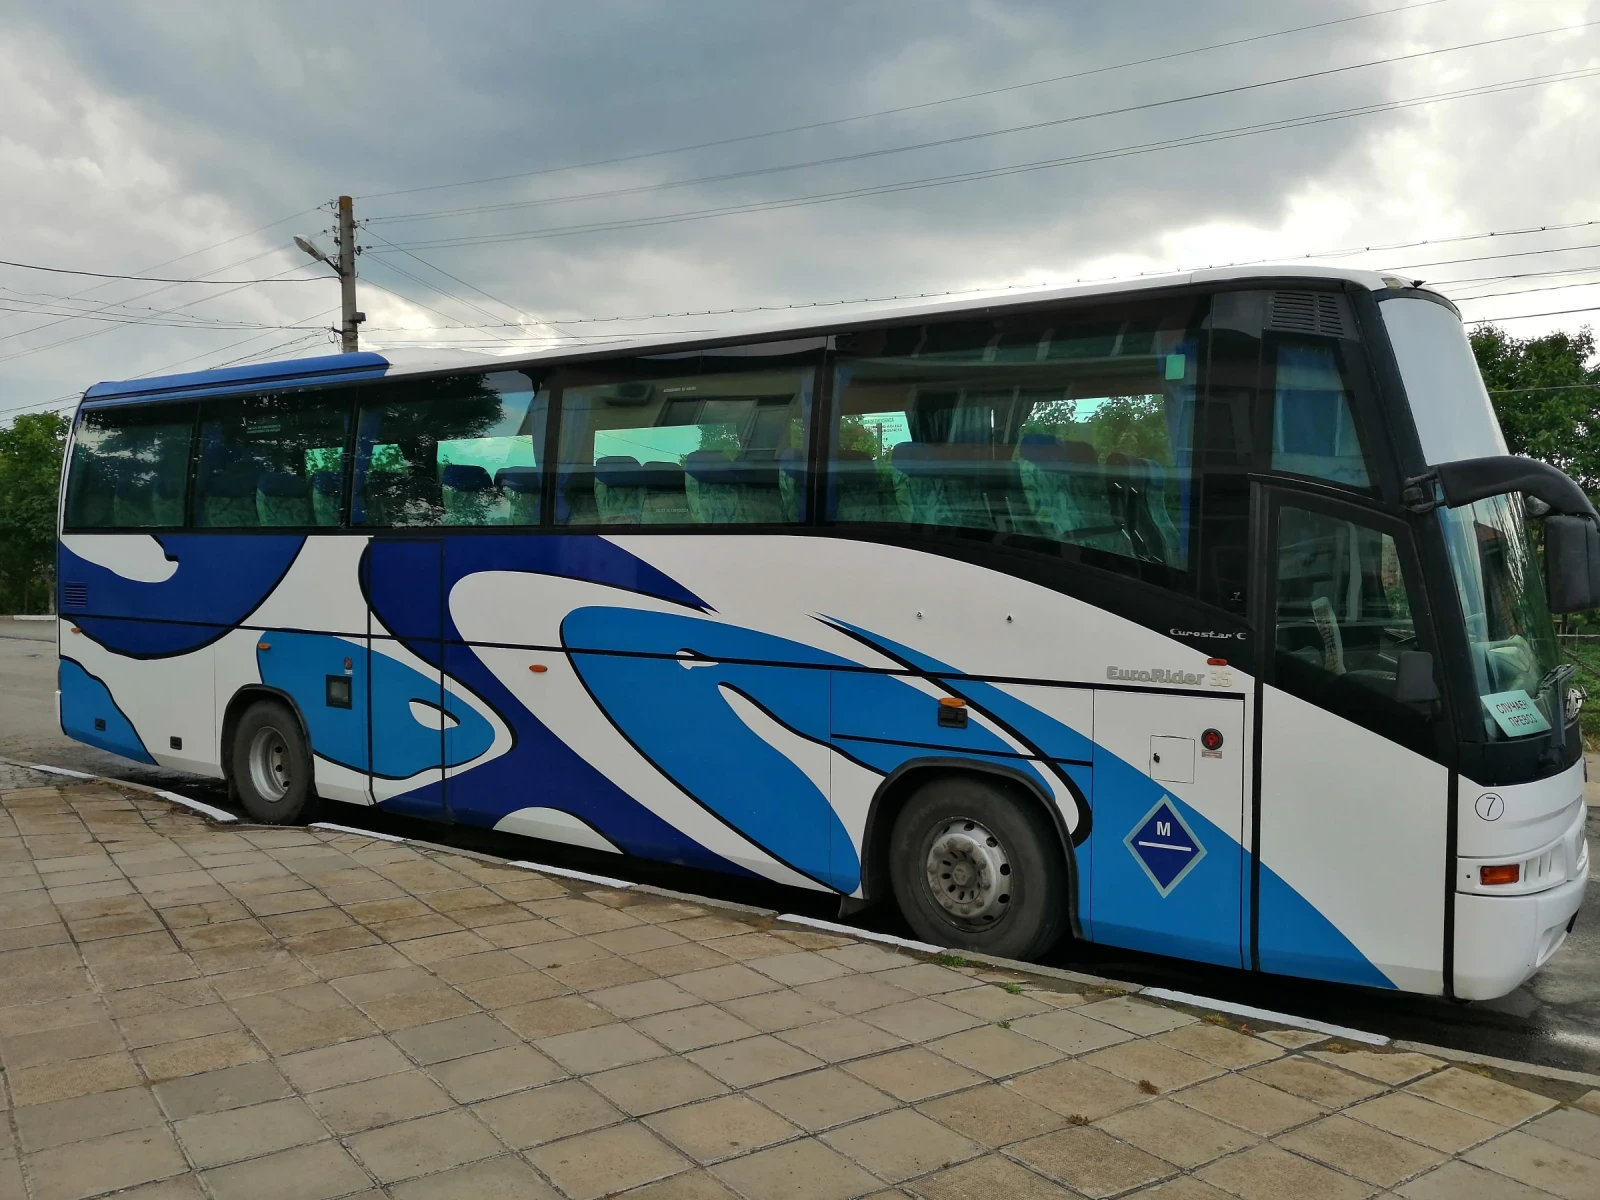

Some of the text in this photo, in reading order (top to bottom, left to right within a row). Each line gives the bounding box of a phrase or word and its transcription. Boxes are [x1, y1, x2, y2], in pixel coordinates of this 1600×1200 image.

[1106, 666, 1233, 687] EuroRider 35
[1495, 700, 1530, 714] СЛУЧАЕН
[1508, 713, 1538, 727] ПРЕВОЗ
[1485, 796, 1496, 817] 7
[1156, 821, 1171, 837] M
